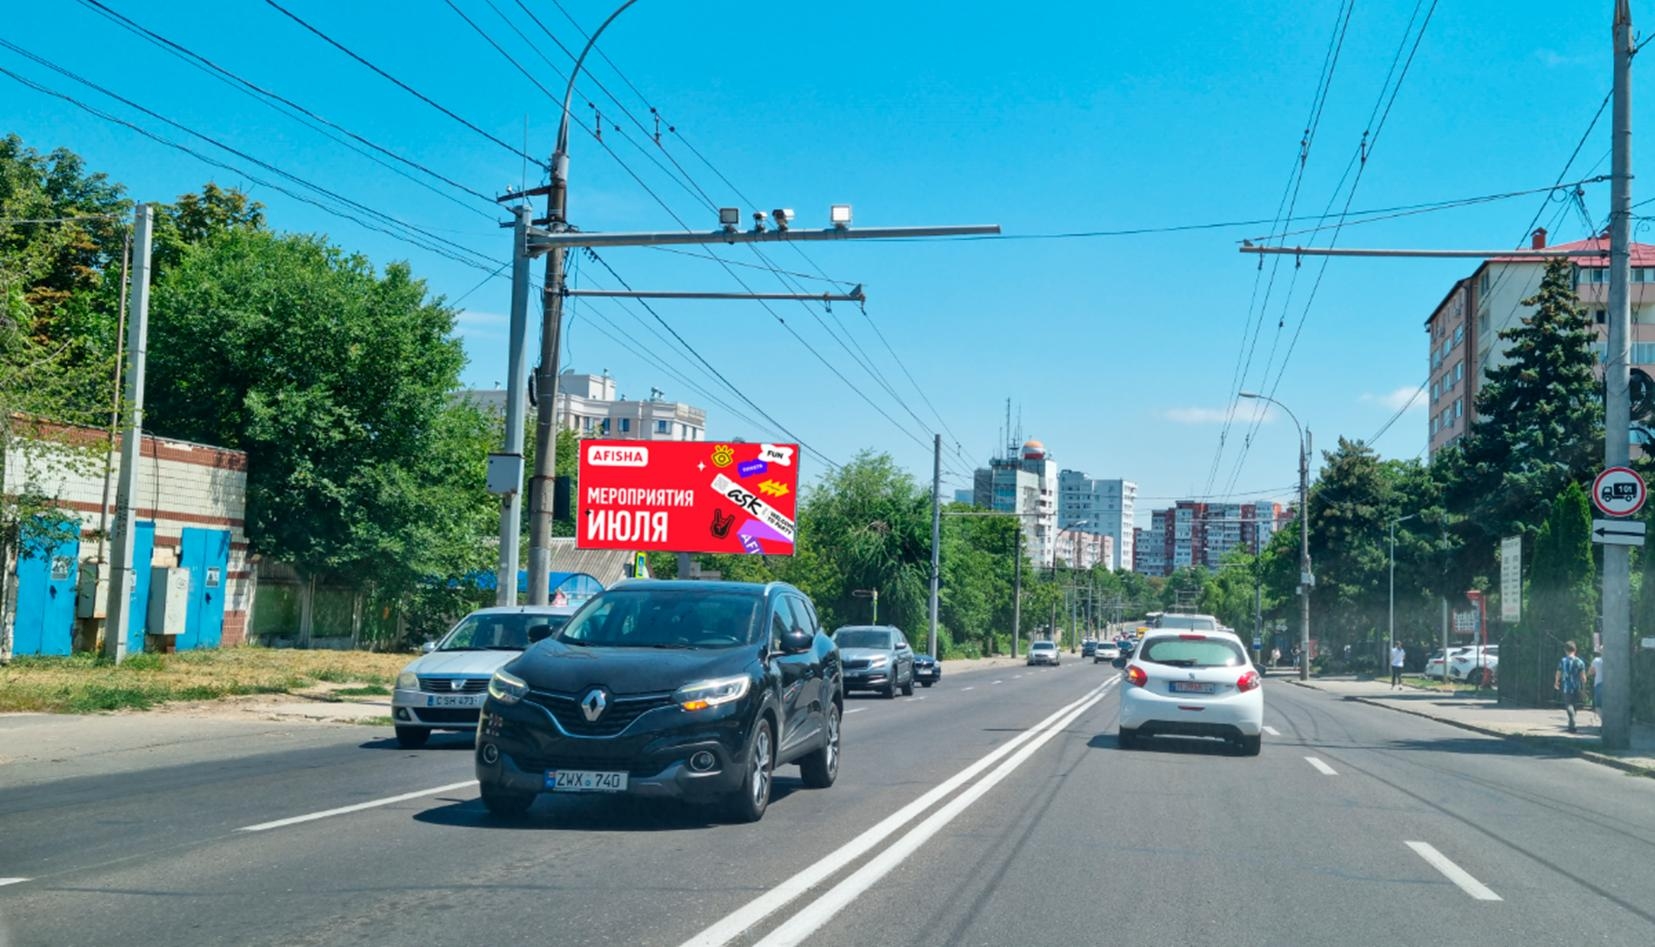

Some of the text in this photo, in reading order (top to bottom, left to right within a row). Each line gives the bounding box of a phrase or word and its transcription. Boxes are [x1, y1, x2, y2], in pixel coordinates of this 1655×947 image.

[593, 447, 643, 462] AFISHA
[767, 450, 783, 459] FUN
[1618, 485, 1632, 493] 10t
[588, 487, 694, 507] МЕРОПРИЯТИЯ
[587, 510, 668, 542] ИЮЛЯ
[771, 511, 794, 530] WELCOM
[775, 522, 792, 535] PARTY
[741, 534, 760, 554] AFI
[557, 773, 620, 788] ZWX 740
